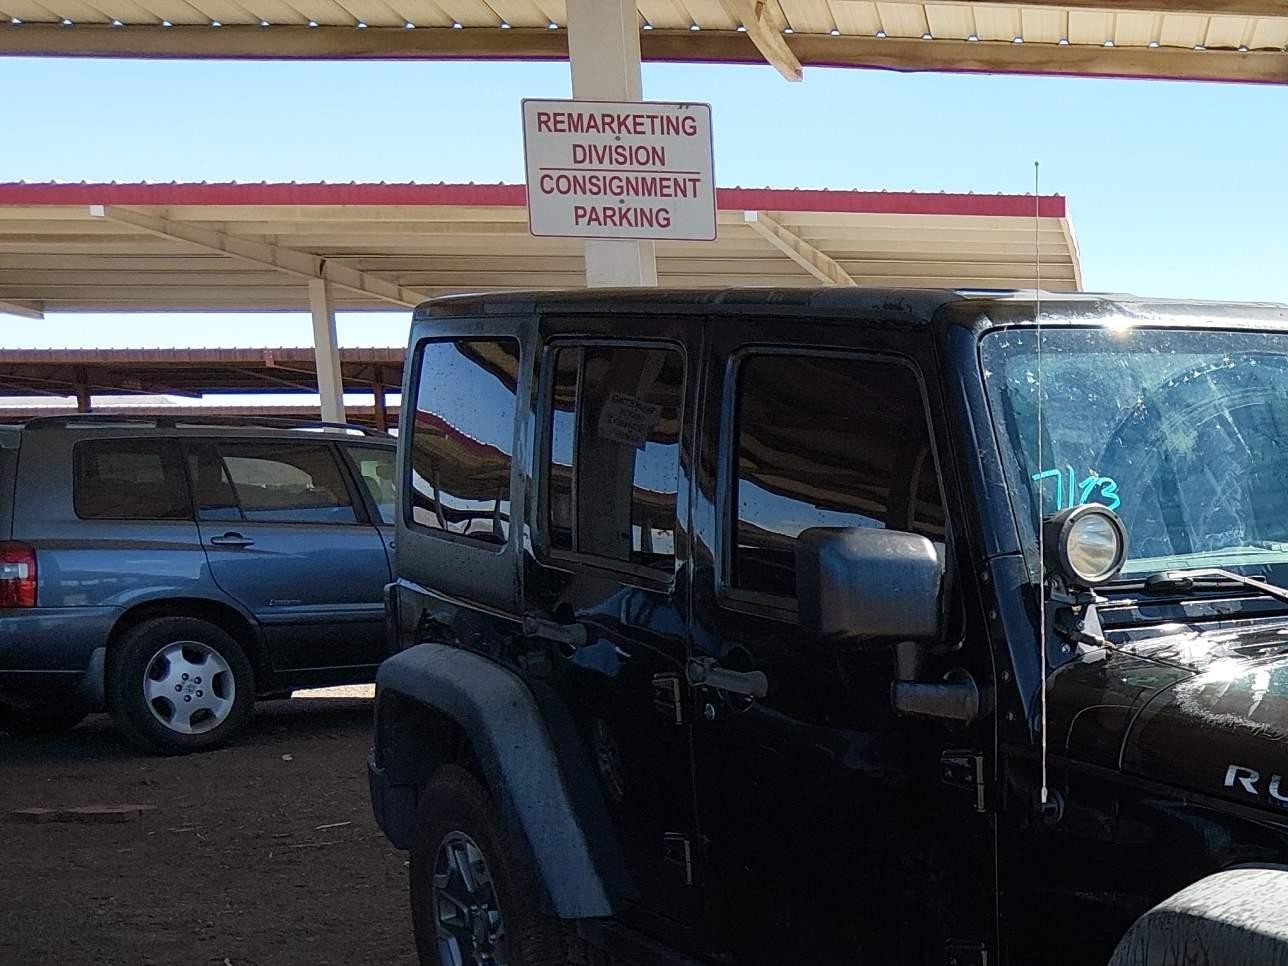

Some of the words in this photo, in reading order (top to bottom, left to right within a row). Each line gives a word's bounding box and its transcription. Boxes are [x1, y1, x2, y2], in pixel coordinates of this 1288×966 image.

[537, 112, 698, 137] REMARKETING
[572, 143, 666, 167] DIVISION
[539, 174, 701, 198] CONSIGNMENT
[574, 206, 671, 228] PARKING
